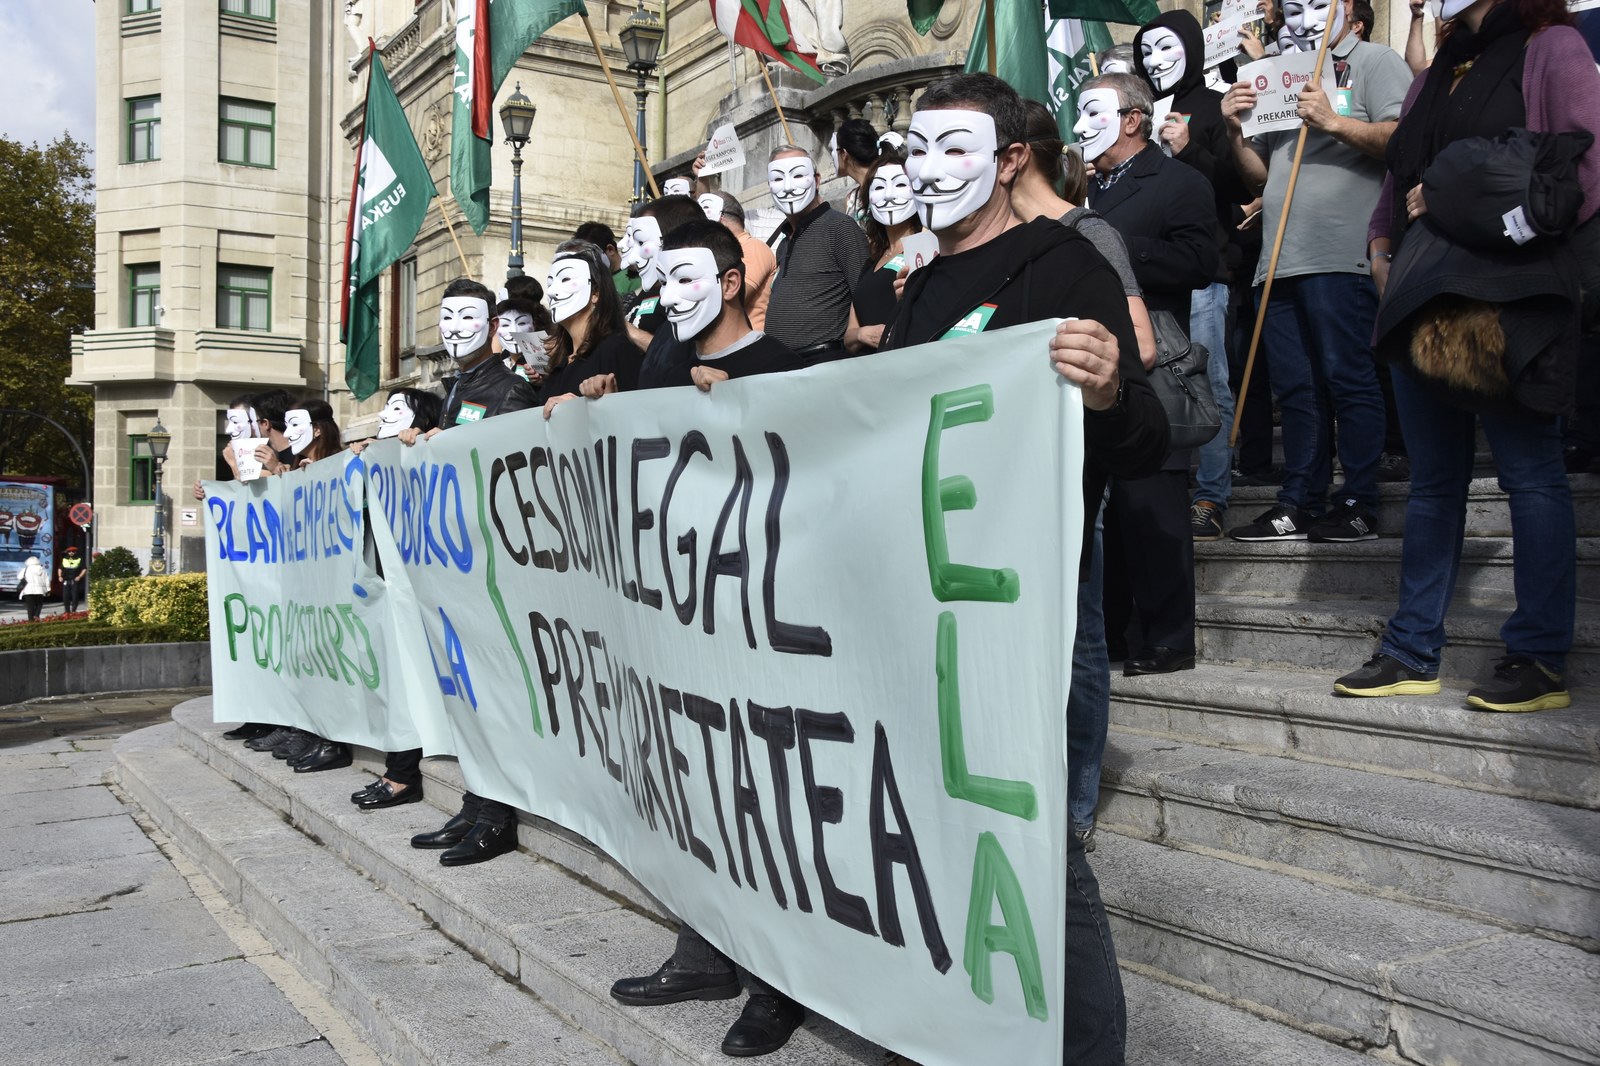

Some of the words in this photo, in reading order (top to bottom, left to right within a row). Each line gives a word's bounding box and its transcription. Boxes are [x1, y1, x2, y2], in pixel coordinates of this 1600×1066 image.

[207, 496, 285, 564] PLAN
[922, 384, 1048, 1022] ELA
[530, 611, 952, 974] PREKARIETATEA
